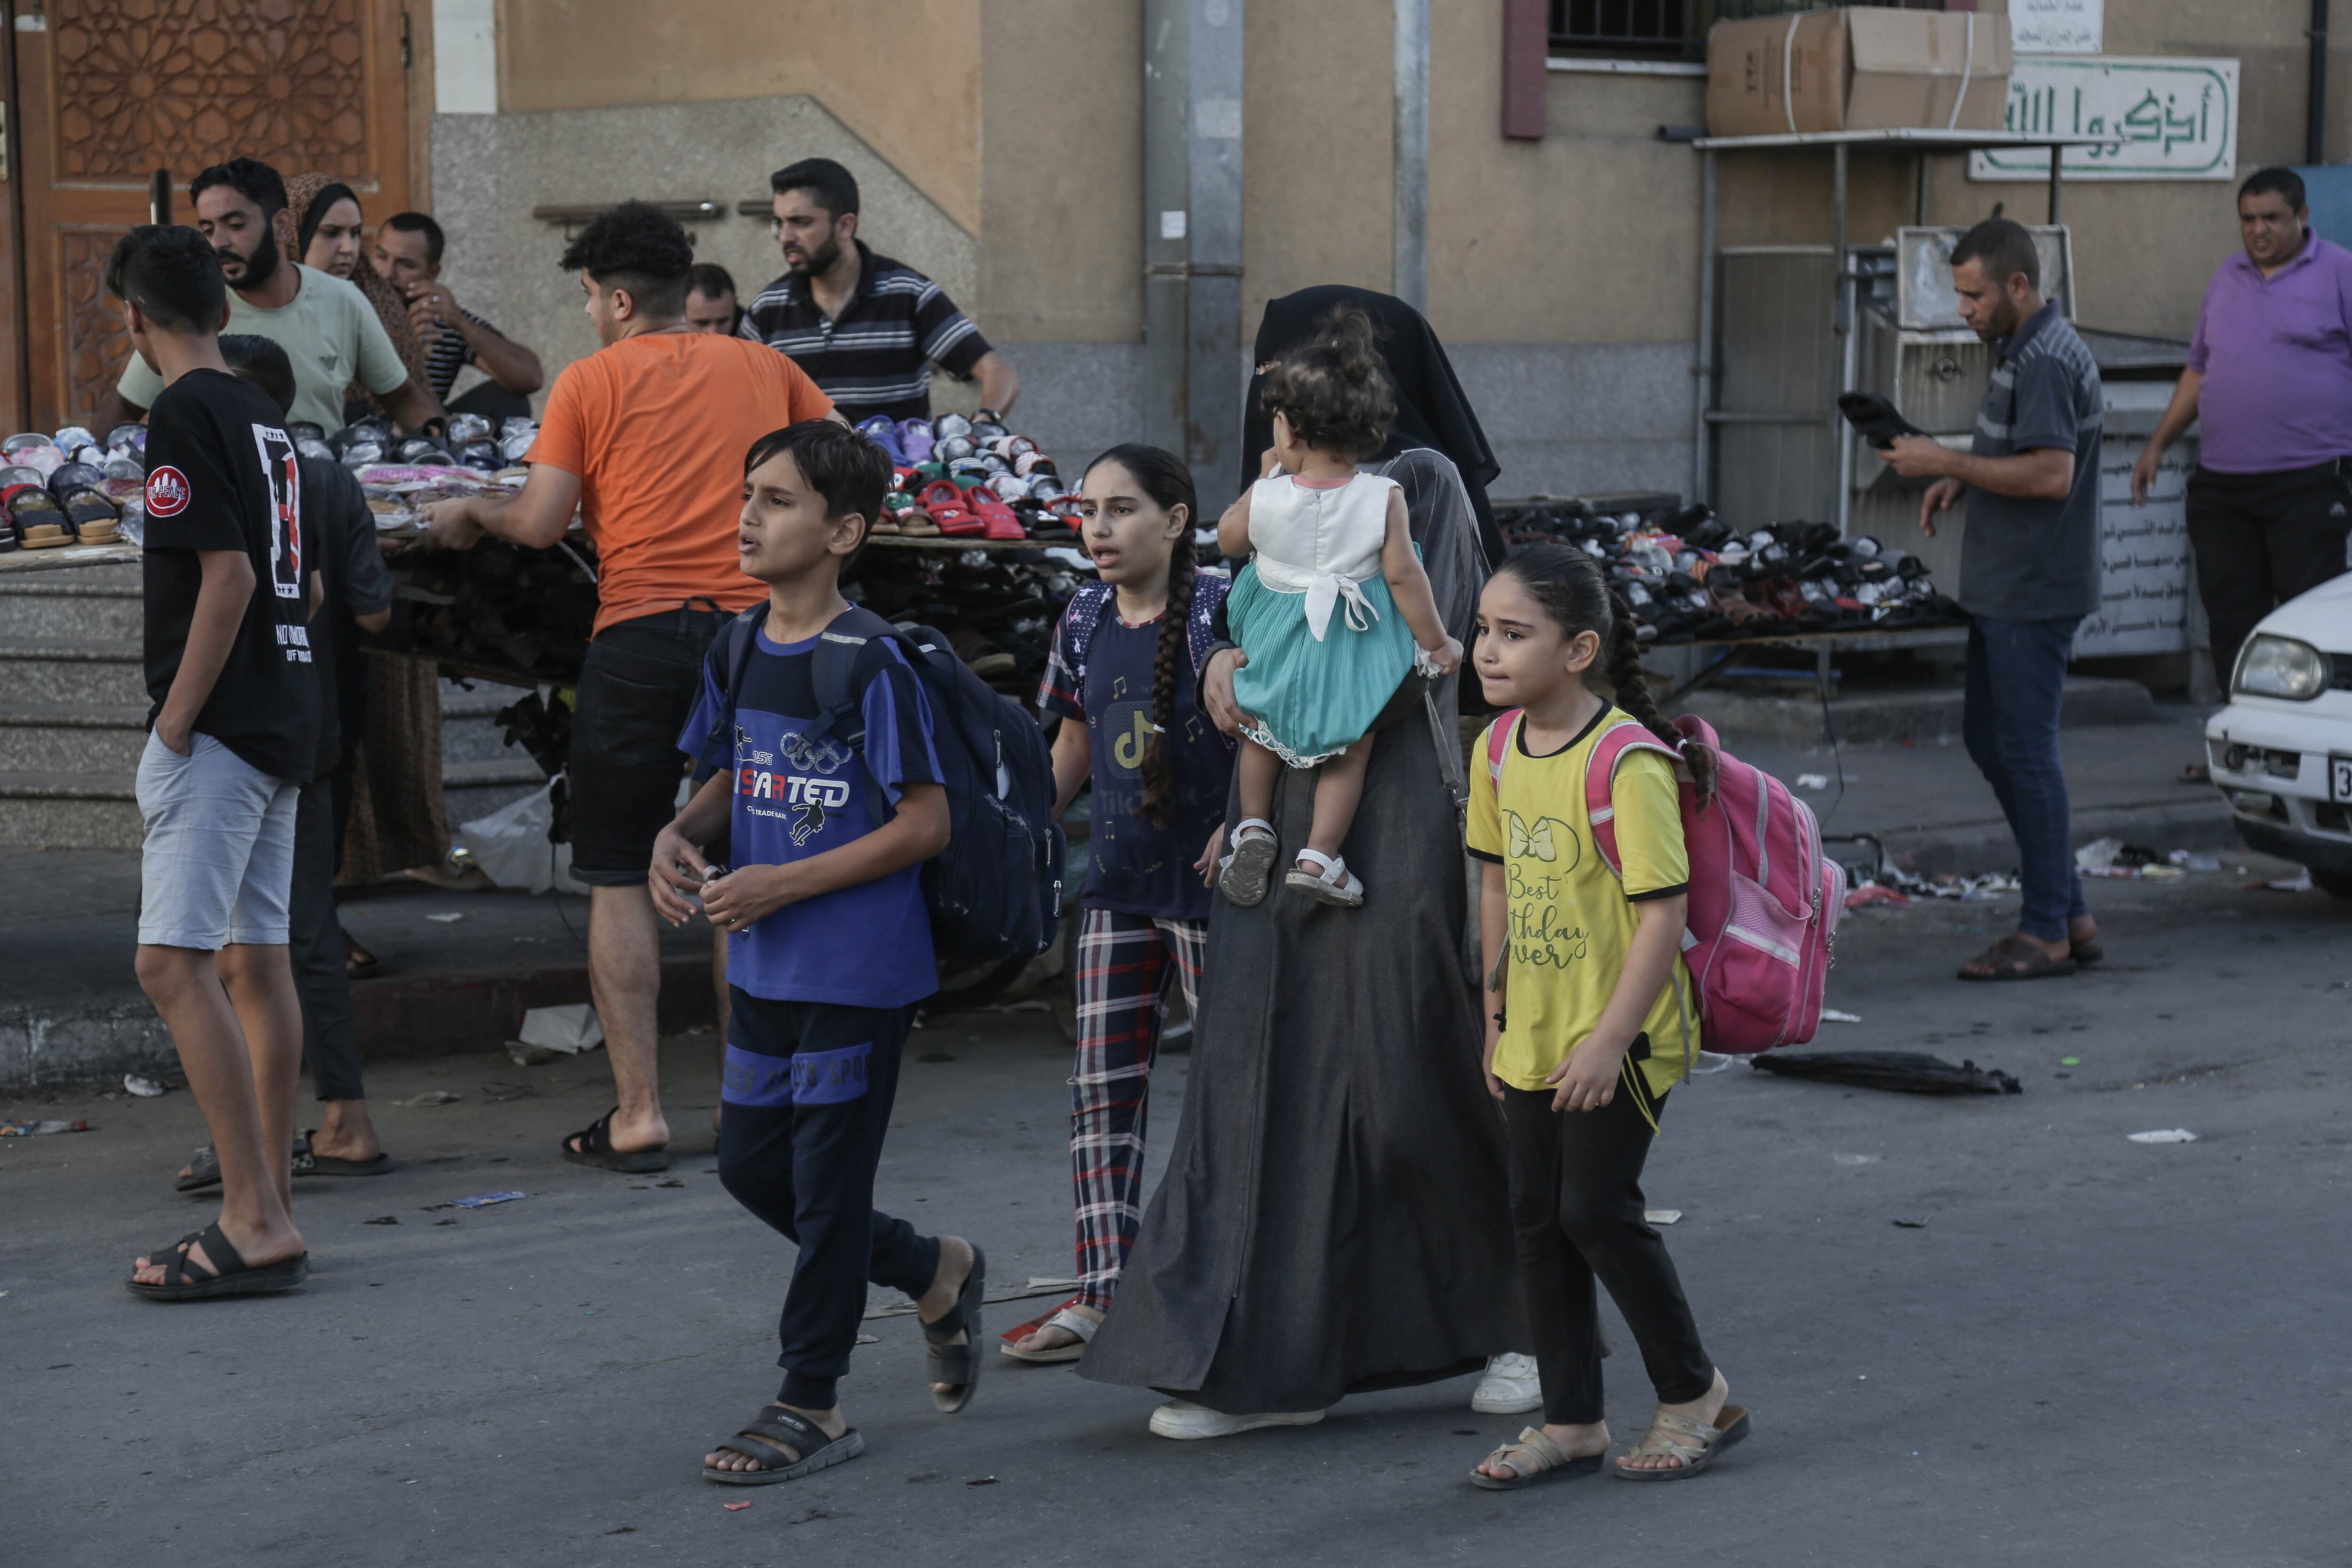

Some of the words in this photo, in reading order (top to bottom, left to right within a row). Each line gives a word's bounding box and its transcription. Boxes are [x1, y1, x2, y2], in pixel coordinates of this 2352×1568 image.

[157, 484, 185, 500] PEACE
[275, 624, 288, 645] NO
[286, 650, 297, 661] OFF
[741, 769, 850, 807] SARTED
[2339, 766, 2352, 796] 3
[1099, 787, 1198, 815] TikTk
[1507, 863, 1562, 900] Best
[1509, 902, 1589, 959] thday
[1512, 944, 1573, 970] ver
